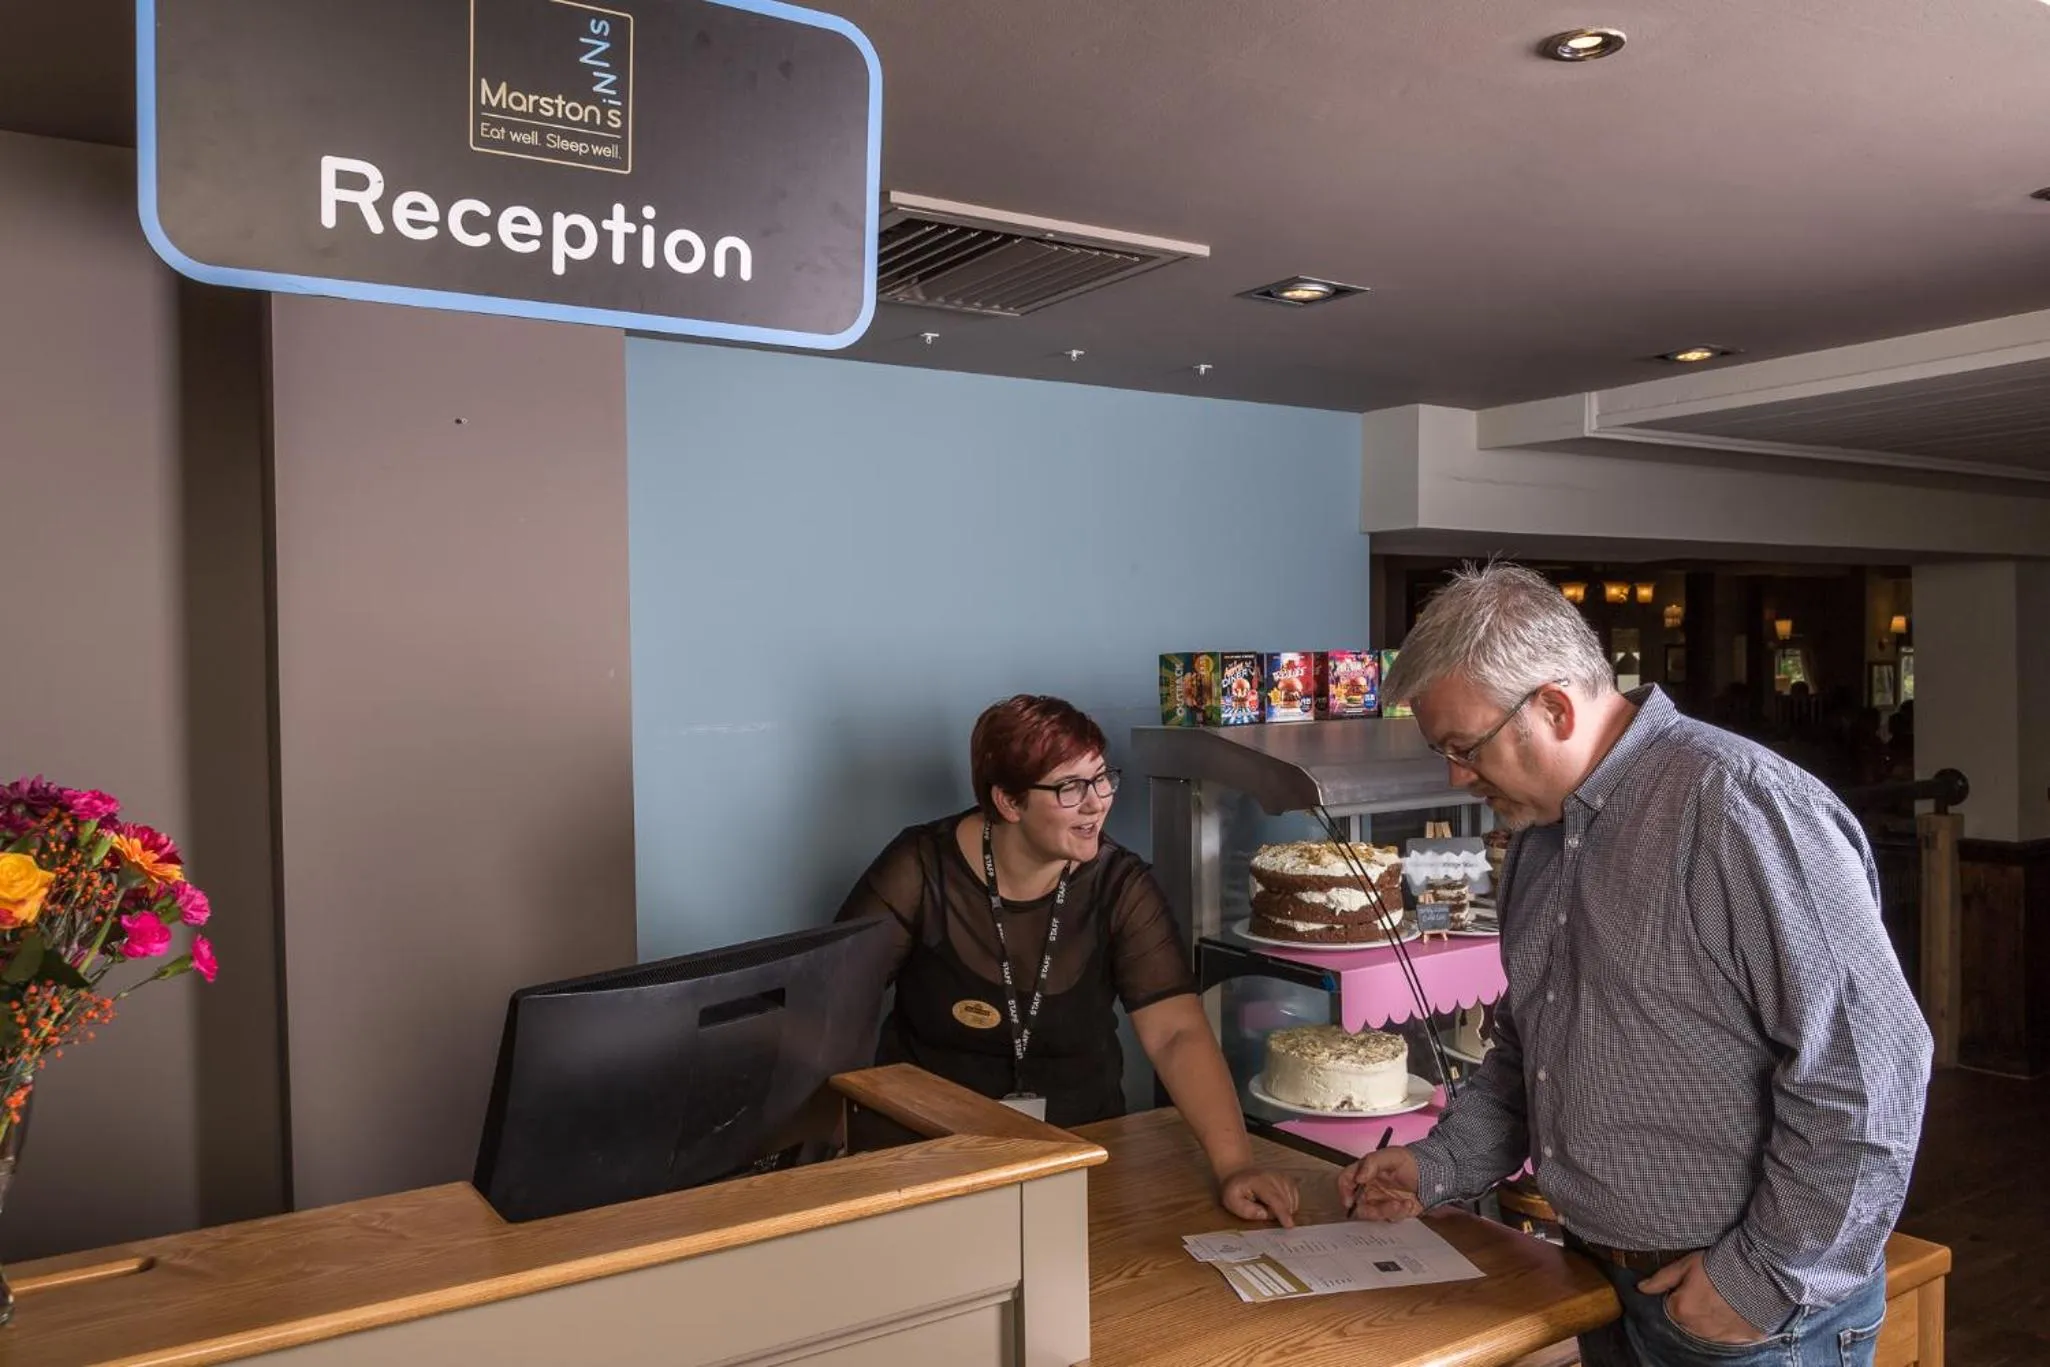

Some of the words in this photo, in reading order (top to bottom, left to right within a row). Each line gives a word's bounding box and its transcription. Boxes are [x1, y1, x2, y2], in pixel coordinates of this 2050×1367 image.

[480, 122, 506, 140] Eat
[509, 130, 541, 146] well.
[545, 133, 589, 156] Sleep
[591, 143, 622, 160] well.
[320, 155, 752, 281] Reception
[984, 854, 995, 877] STAFF
[1056, 881, 1067, 904] STAFF
[1049, 918, 1060, 942] STAFF
[1003, 961, 1012, 985] STAFF
[1040, 954, 1051, 979] STAFF
[1008, 1000, 1020, 1024] STAFF
[1030, 991, 1042, 1016] STAFF
